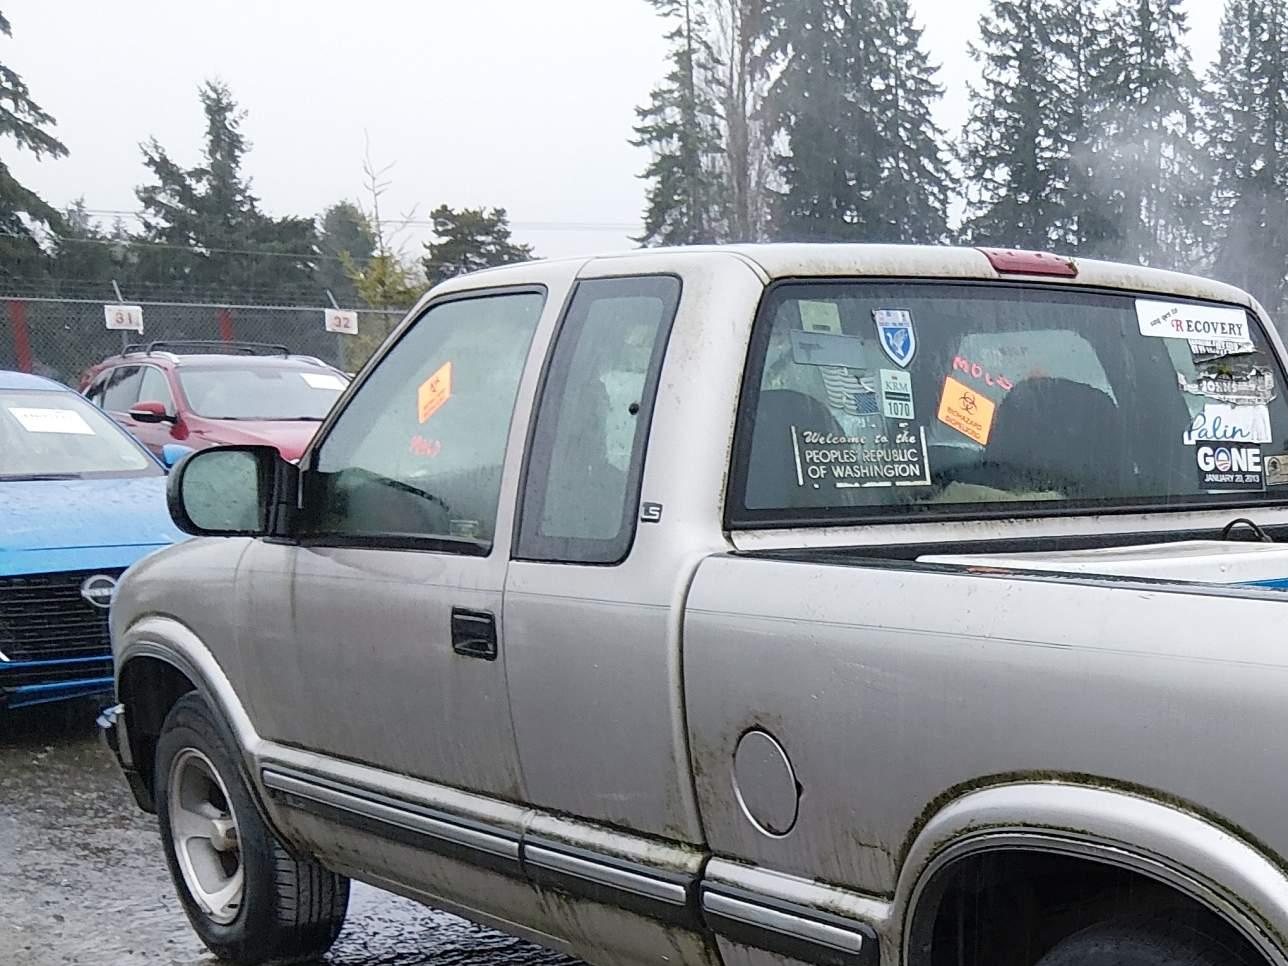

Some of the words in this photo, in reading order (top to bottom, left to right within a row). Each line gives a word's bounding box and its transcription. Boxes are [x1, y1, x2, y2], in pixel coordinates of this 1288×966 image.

[1171, 319, 1243, 337] RECOVERY
[887, 401, 911, 417] 1070
[1188, 409, 1251, 440] Palin
[803, 431, 865, 444] Welcome
[874, 433, 889, 443] to
[895, 429, 917, 443] the
[862, 448, 919, 462] REPUBLIC
[1197, 446, 1262, 472] GONE
[807, 465, 828, 479] OF
[831, 463, 920, 478] WASHINGTON
[1204, 473, 1234, 483] JANUARY
